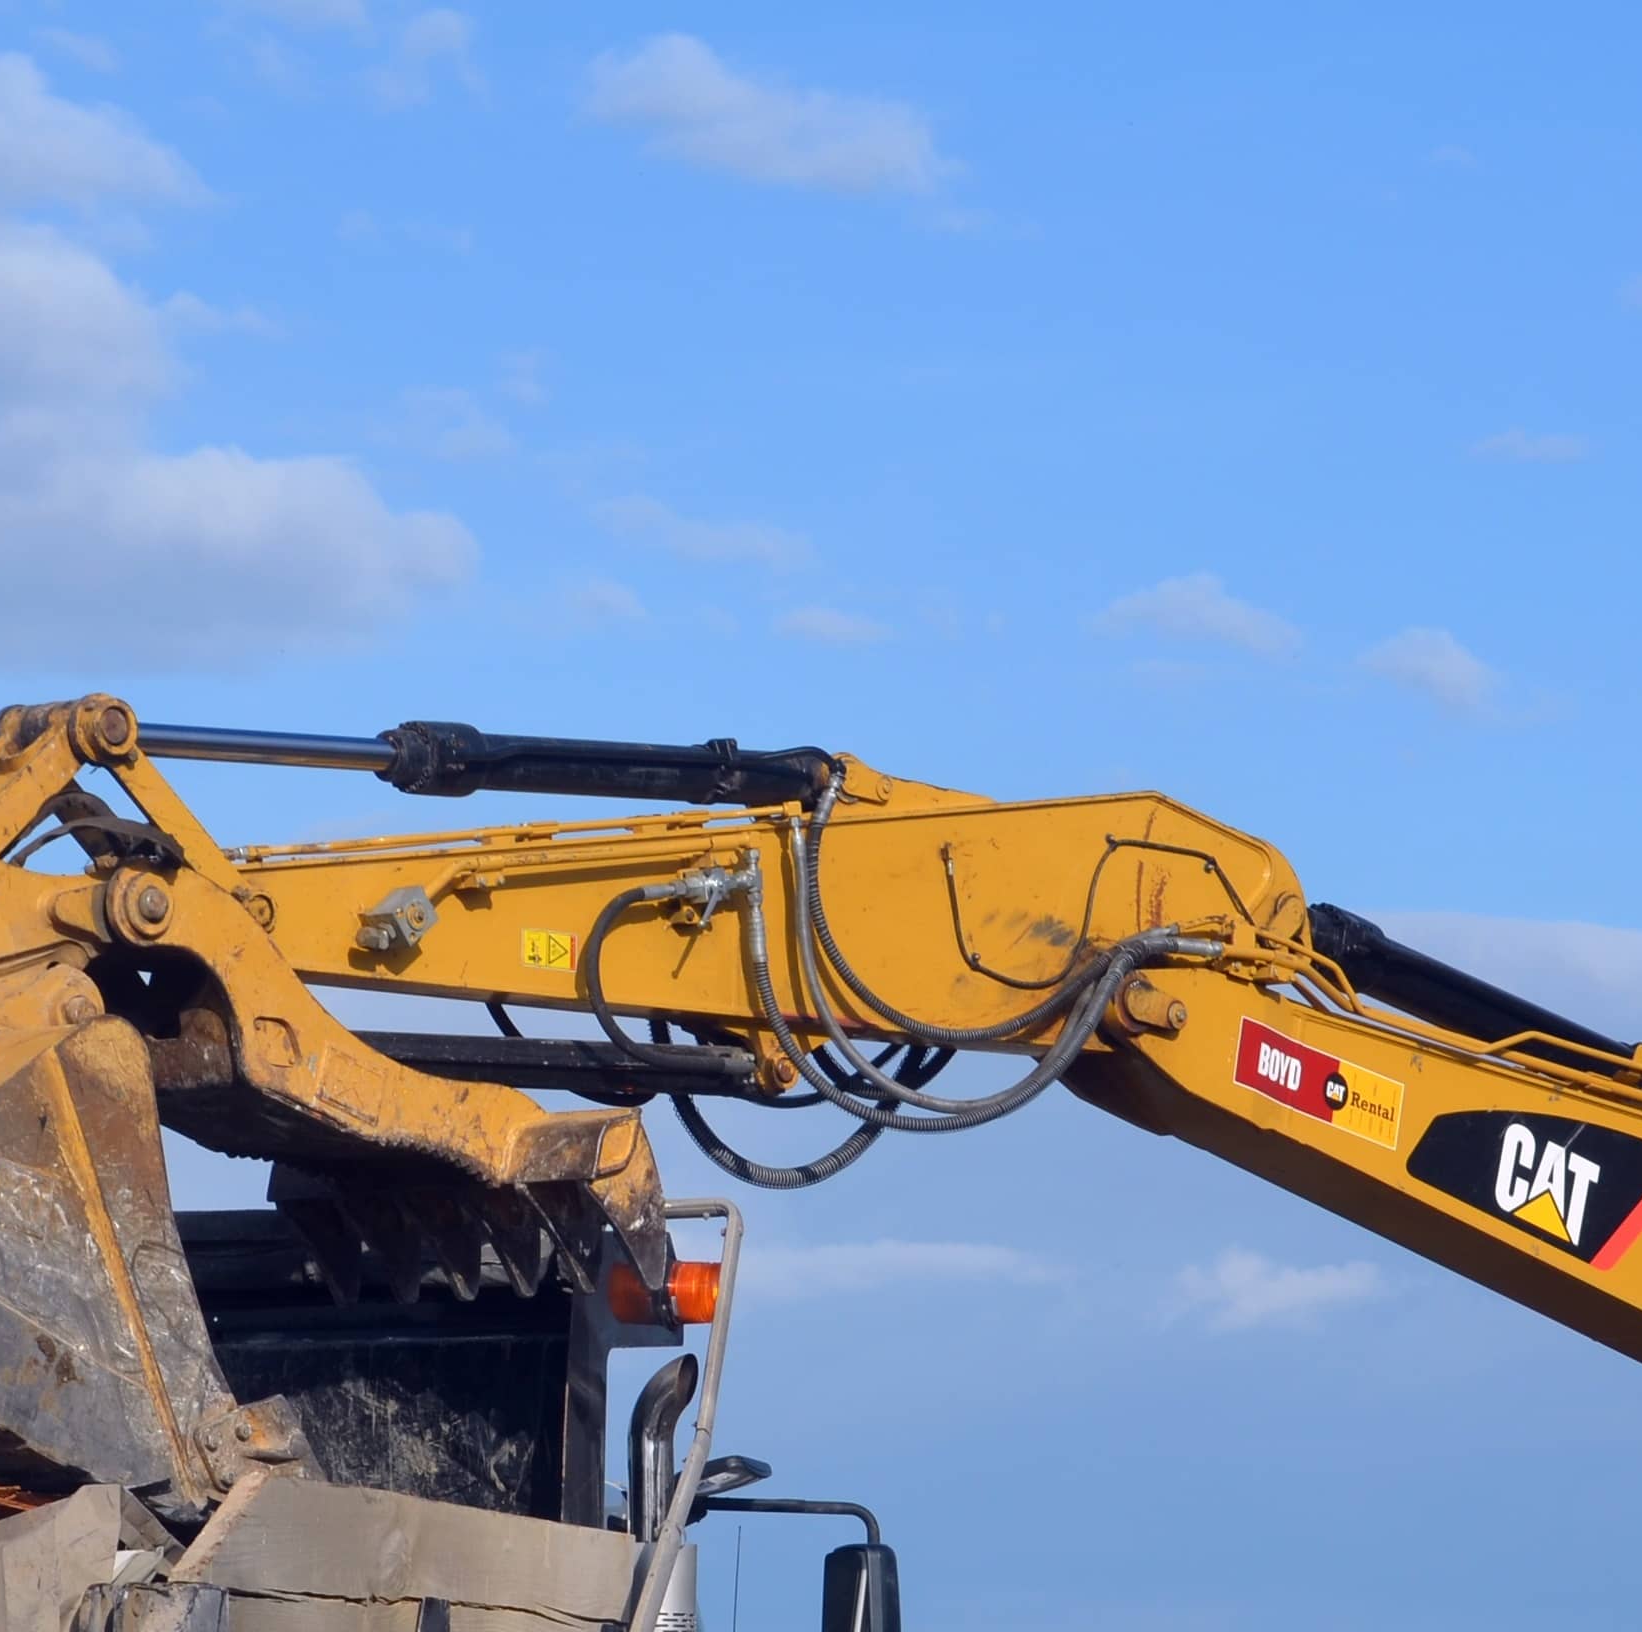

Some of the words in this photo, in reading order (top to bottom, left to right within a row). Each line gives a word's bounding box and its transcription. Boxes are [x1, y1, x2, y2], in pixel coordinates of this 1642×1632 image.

[1257, 1041, 1302, 1092] BOYD
[1325, 1080, 1346, 1102] CAT
[1350, 1091, 1395, 1122] Rental
[1495, 1123, 1601, 1247] CAT
